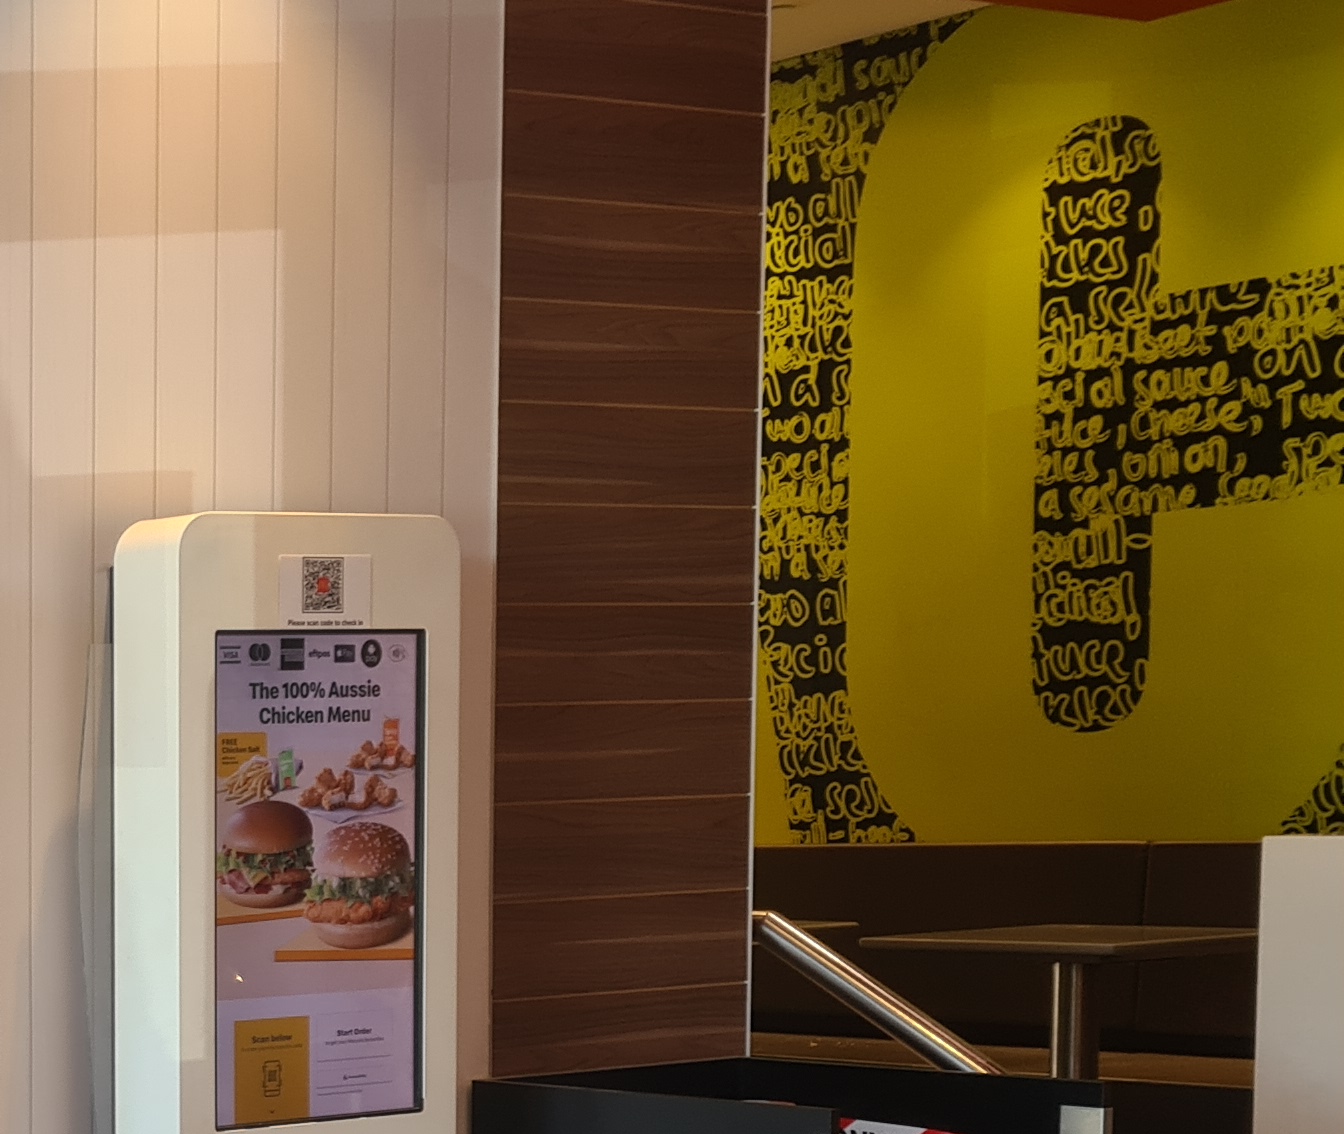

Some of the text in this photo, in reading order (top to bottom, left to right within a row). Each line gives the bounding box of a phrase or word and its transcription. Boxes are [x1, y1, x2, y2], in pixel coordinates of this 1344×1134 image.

[249, 679, 381, 699] The 100% Aussie
[259, 706, 371, 724] Chicken Menu
